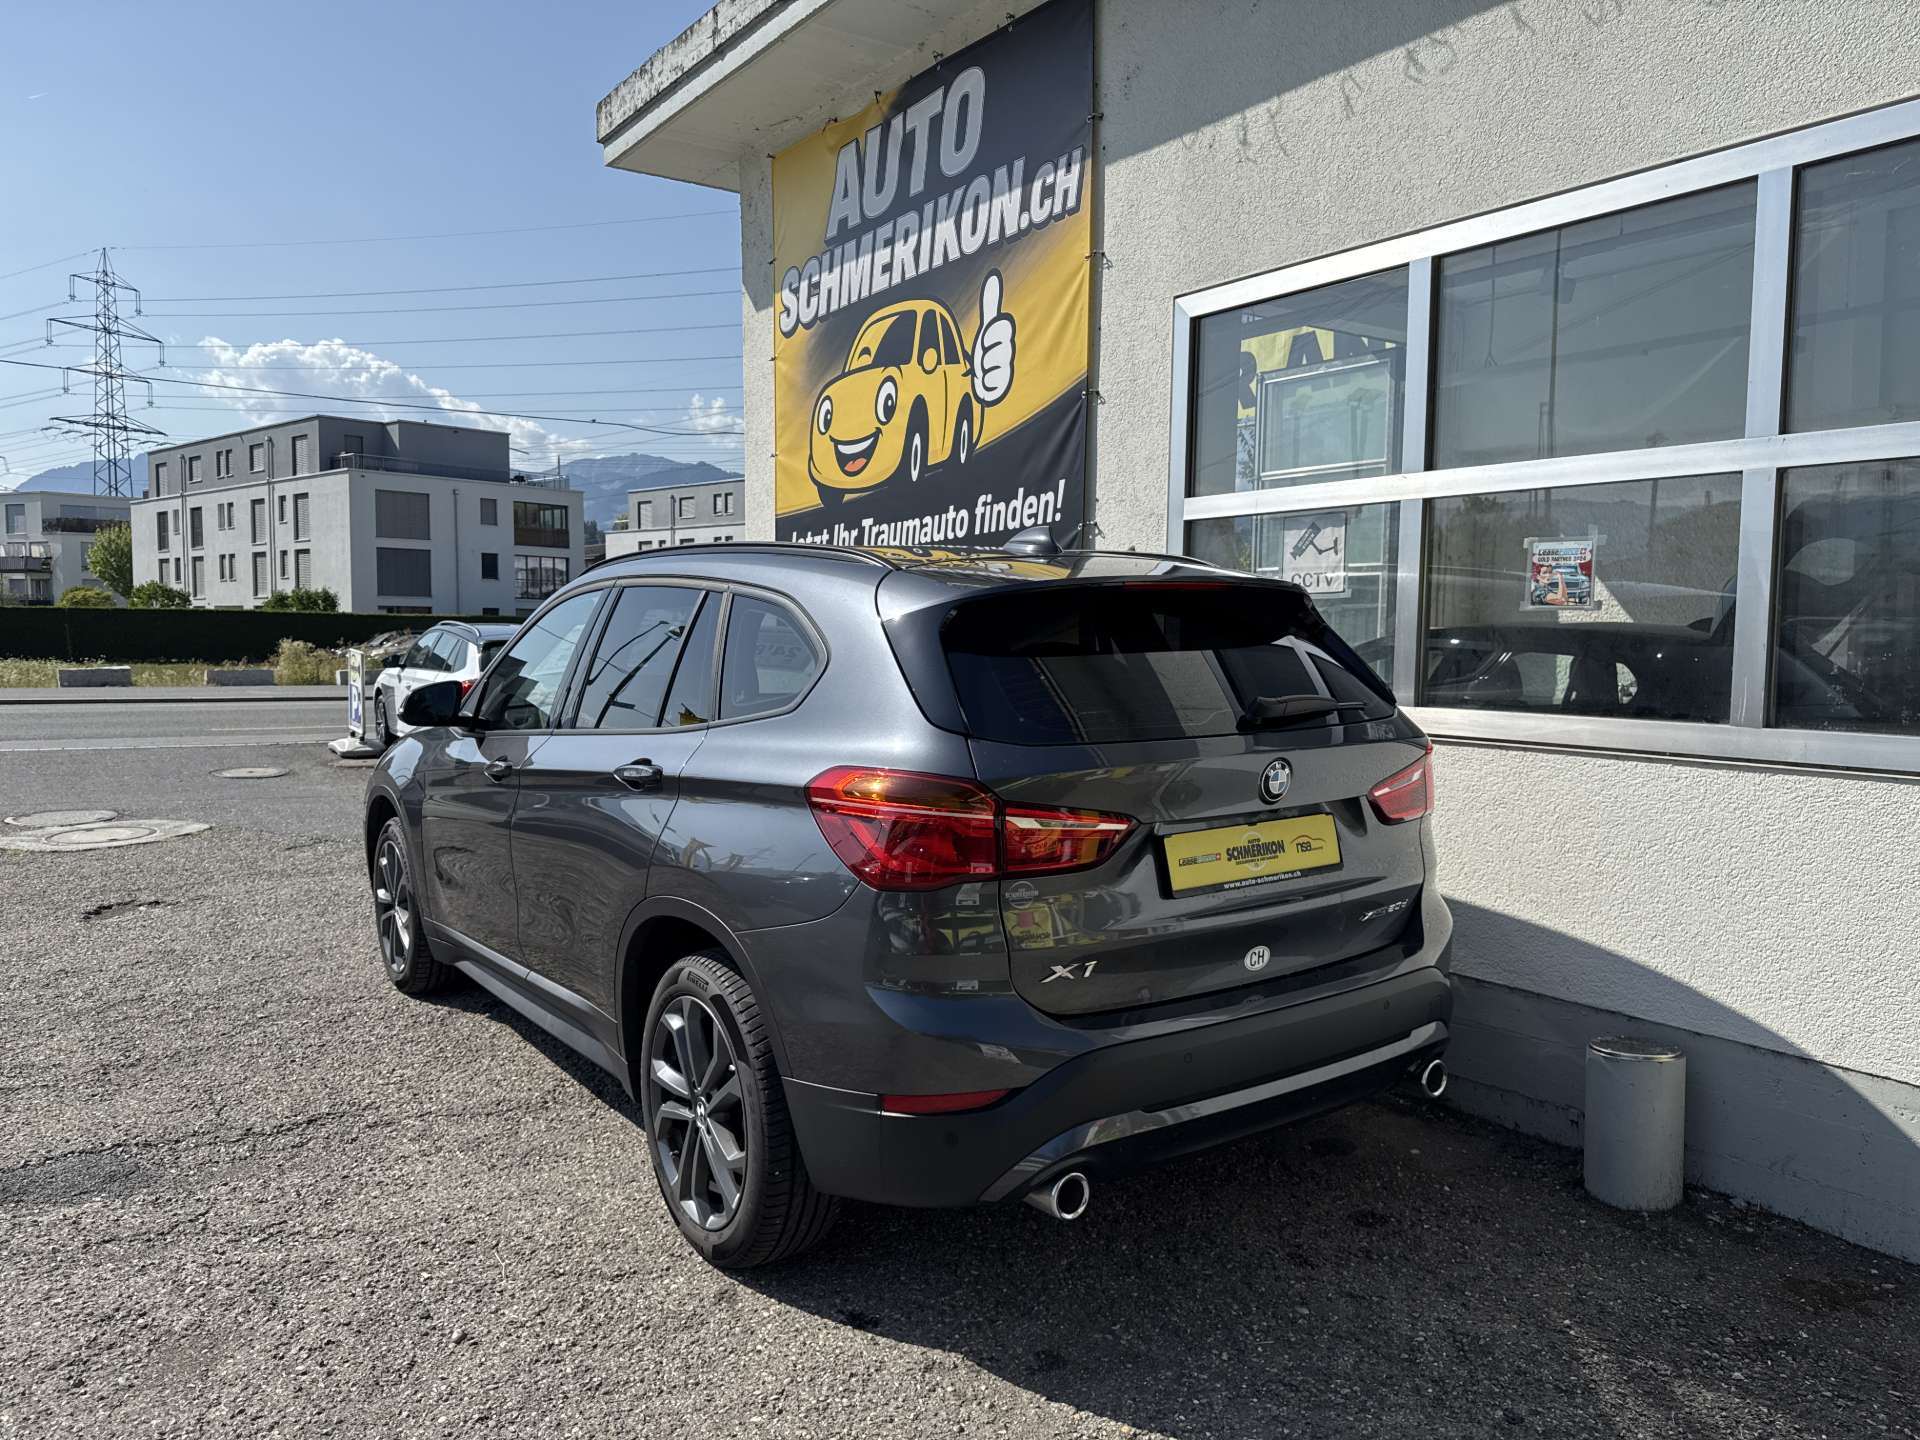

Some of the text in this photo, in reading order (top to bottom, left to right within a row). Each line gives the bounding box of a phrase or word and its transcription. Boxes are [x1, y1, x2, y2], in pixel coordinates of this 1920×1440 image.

[826, 66, 986, 240] AUTO
[780, 147, 1084, 333] SCHMERIKON.CH
[833, 523, 858, 546] Ihr
[862, 505, 968, 546] Traumauto
[975, 479, 1065, 535] finden!
[1291, 571, 1334, 588] CCTV
[1226, 840, 1285, 862] SCHMERIKON
[1250, 949, 1265, 967] CH
[1041, 960, 1097, 983] X1
